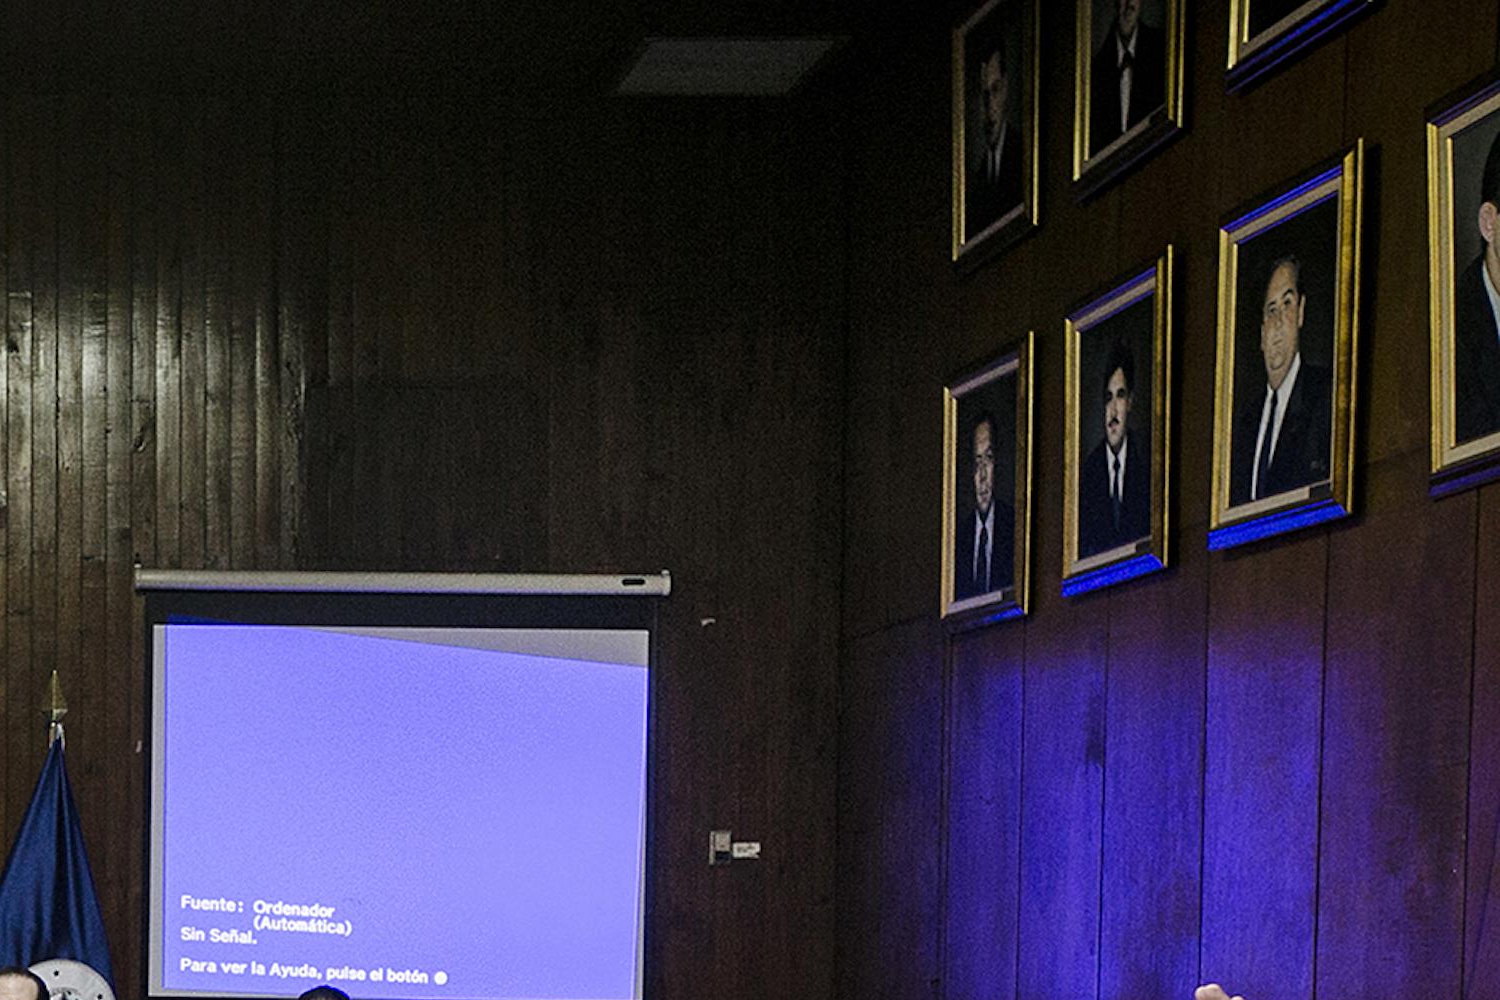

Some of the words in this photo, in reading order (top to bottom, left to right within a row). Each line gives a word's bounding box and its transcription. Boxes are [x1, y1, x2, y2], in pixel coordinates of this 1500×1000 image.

[253, 900, 335, 917] Ordenador
[180, 926, 205, 941] Sin
[210, 928, 257, 945] Señal.
[253, 917, 352, 936] (Automática)
[180, 958, 217, 973] Para
[221, 962, 247, 974] ver
[251, 961, 265, 975] la
[269, 964, 323, 980] Ayuda,
[326, 965, 366, 981] pulse
[370, 968, 383, 981] el
[387, 969, 428, 984] botón
